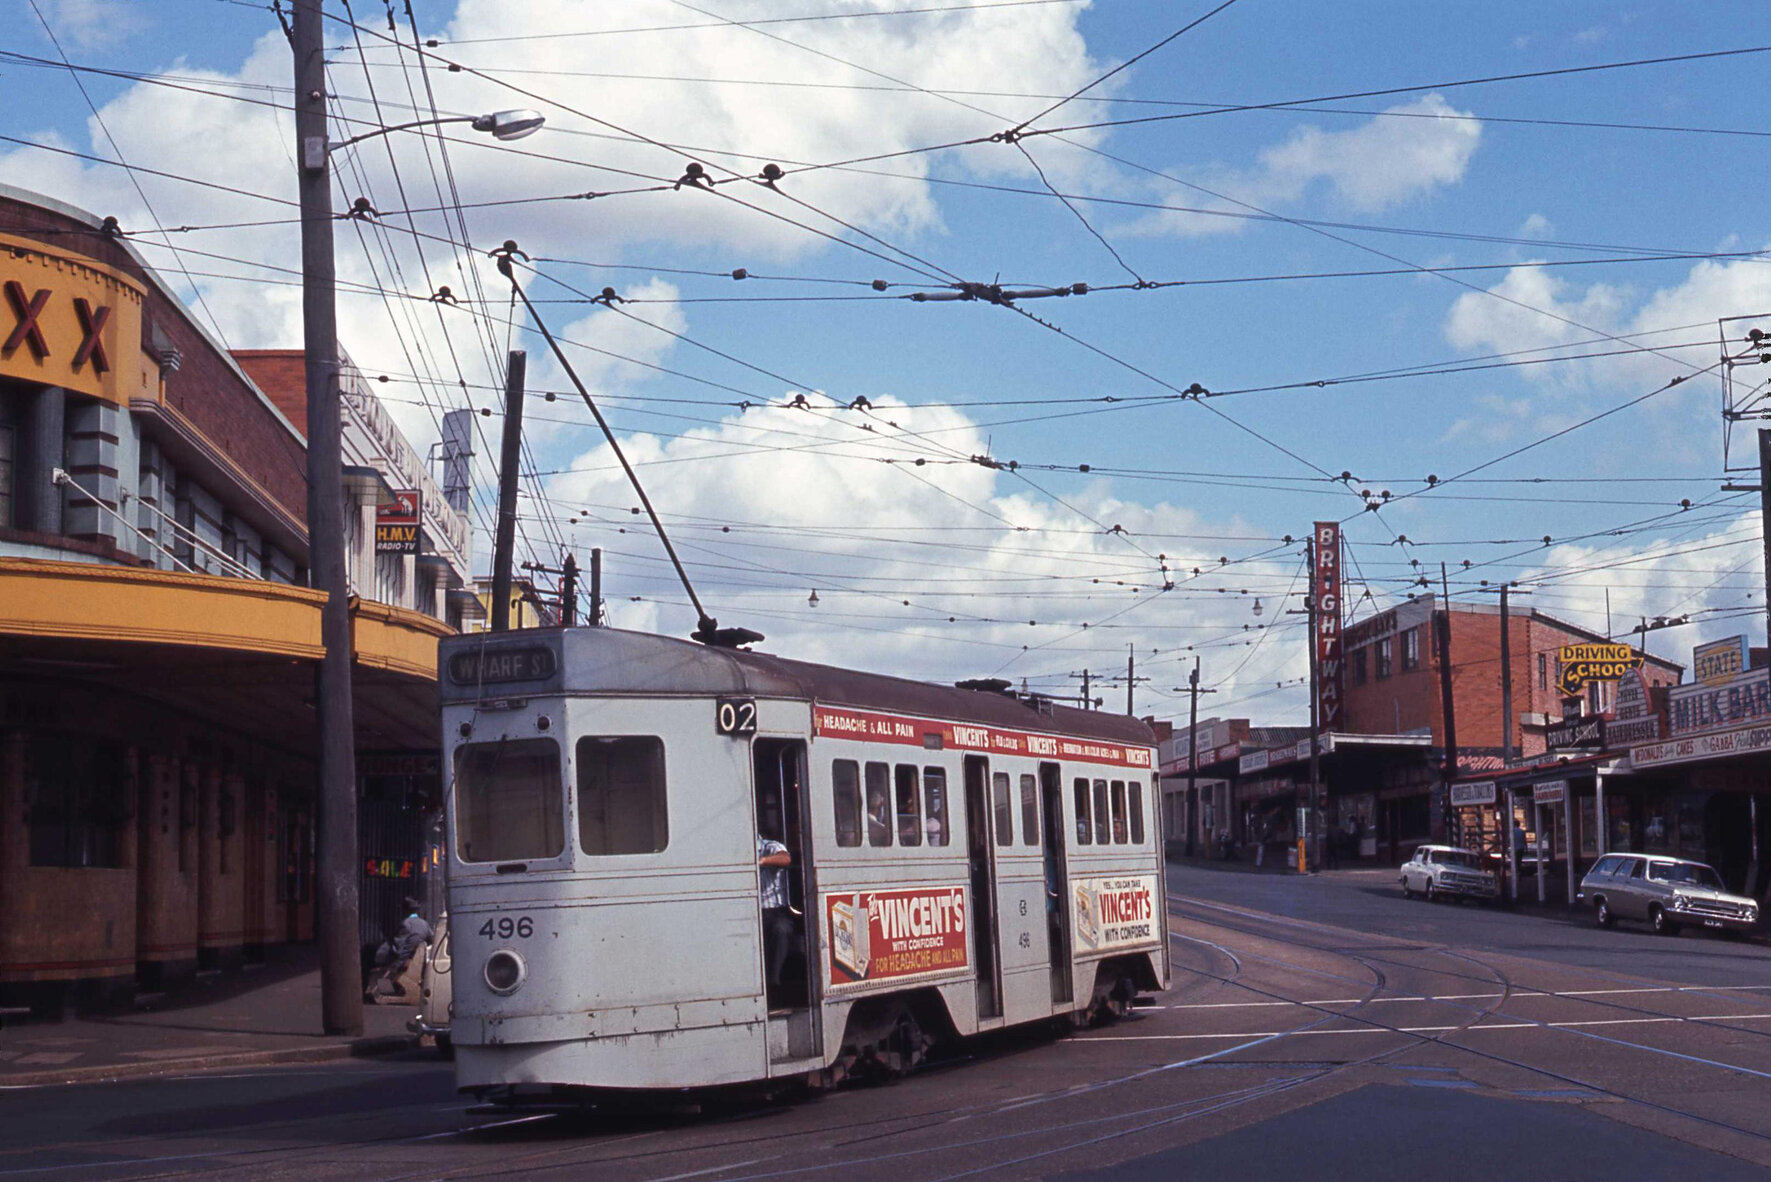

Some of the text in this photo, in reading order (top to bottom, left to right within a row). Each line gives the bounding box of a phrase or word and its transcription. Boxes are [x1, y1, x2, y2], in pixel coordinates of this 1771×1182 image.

[377, 527, 416, 541] H.M.V.
[1564, 647, 1628, 660] DRIVING
[1701, 651, 1737, 678] STATE
[461, 652, 548, 679] WHARF ST
[1567, 663, 1632, 684] SCHOO
[720, 703, 755, 731] 02
[1674, 689, 1723, 731] MILK
[823, 714, 867, 733] HEADACHE
[877, 721, 892, 735] ALL
[895, 723, 914, 738] PAIN
[1710, 734, 1734, 752] GABBA
[365, 858, 415, 879] SALE
[877, 889, 964, 939] VINCENT'S
[1099, 885, 1151, 924] VINCENT'S
[479, 917, 534, 940] 496
[1104, 924, 1150, 942] WITH CONFIDENCE
[892, 936, 944, 952] WITH CONFIDENCE
[1019, 932, 1030, 949] 496
[875, 957, 889, 973] FOR
[889, 950, 931, 972] HEADACHE
[932, 952, 942, 964] AND
[952, 948, 964, 962] PAIN
